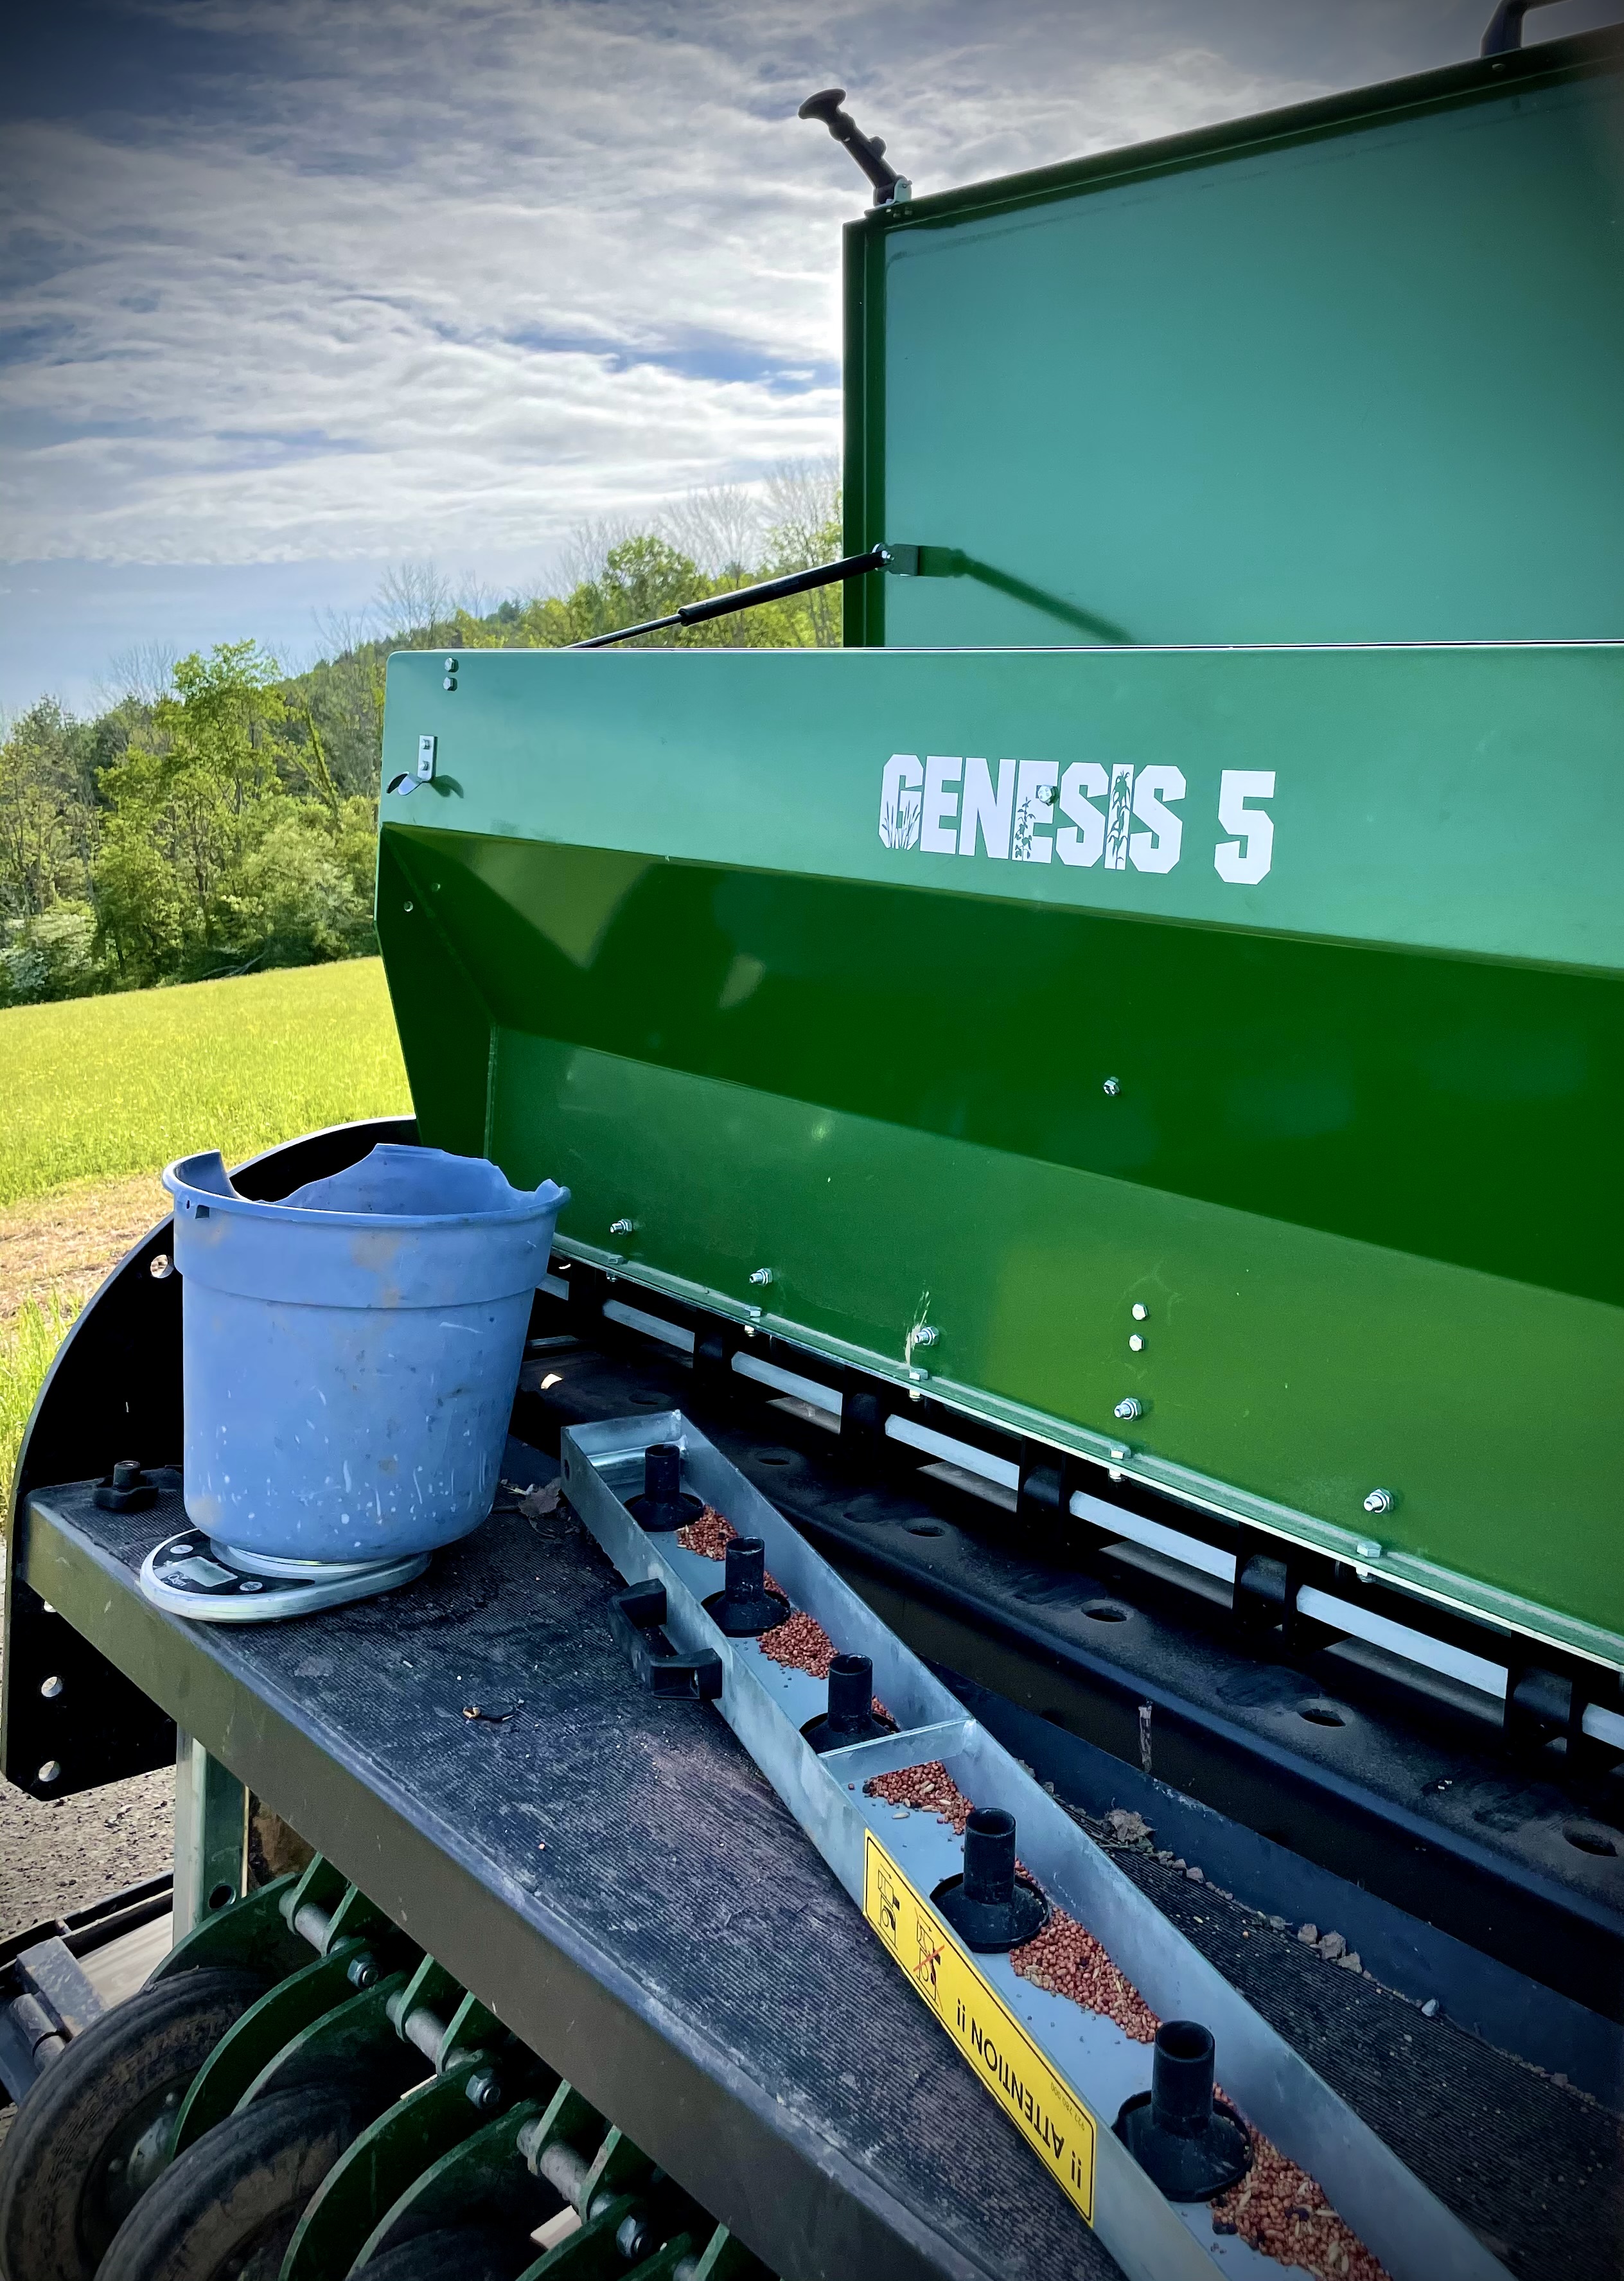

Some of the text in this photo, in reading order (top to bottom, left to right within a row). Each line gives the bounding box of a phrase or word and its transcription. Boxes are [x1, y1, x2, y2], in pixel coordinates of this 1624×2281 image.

[878, 753, 1276, 885] GENESIS 5
[971, 2017, 1065, 2160] ATTENTION
